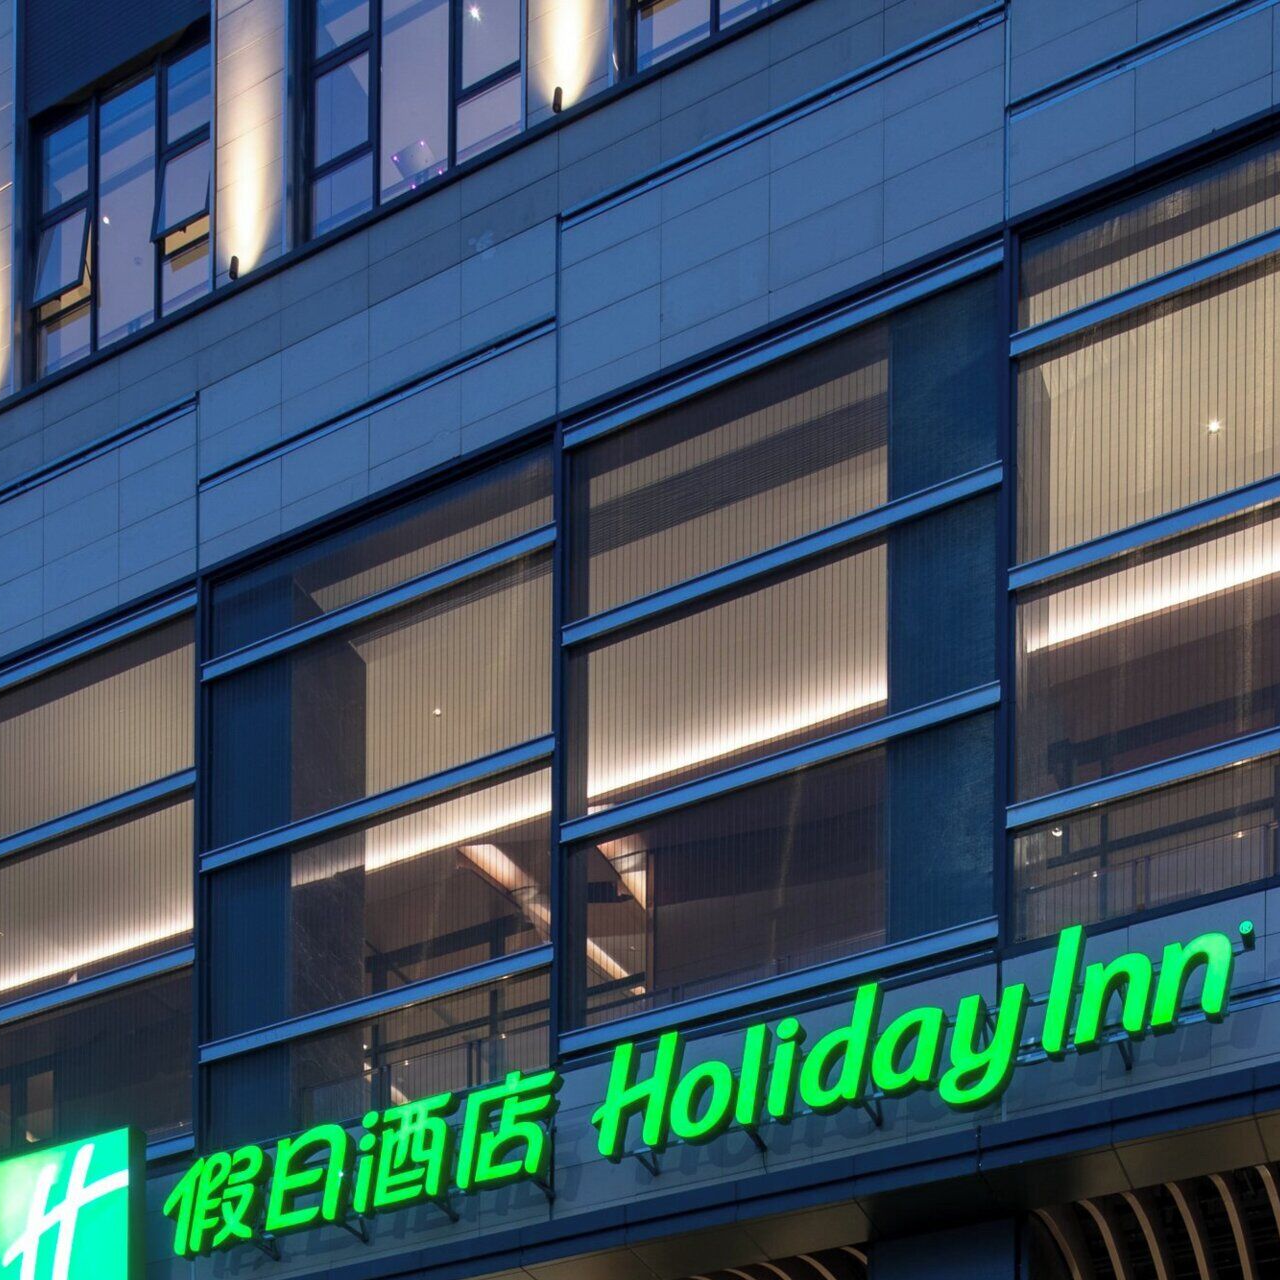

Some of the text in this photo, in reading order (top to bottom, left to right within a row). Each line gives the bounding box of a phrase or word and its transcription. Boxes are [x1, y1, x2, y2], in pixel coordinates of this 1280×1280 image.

[590, 982, 1025, 1156] Holiday
[162, 1070, 557, 1257] 假日酒店
